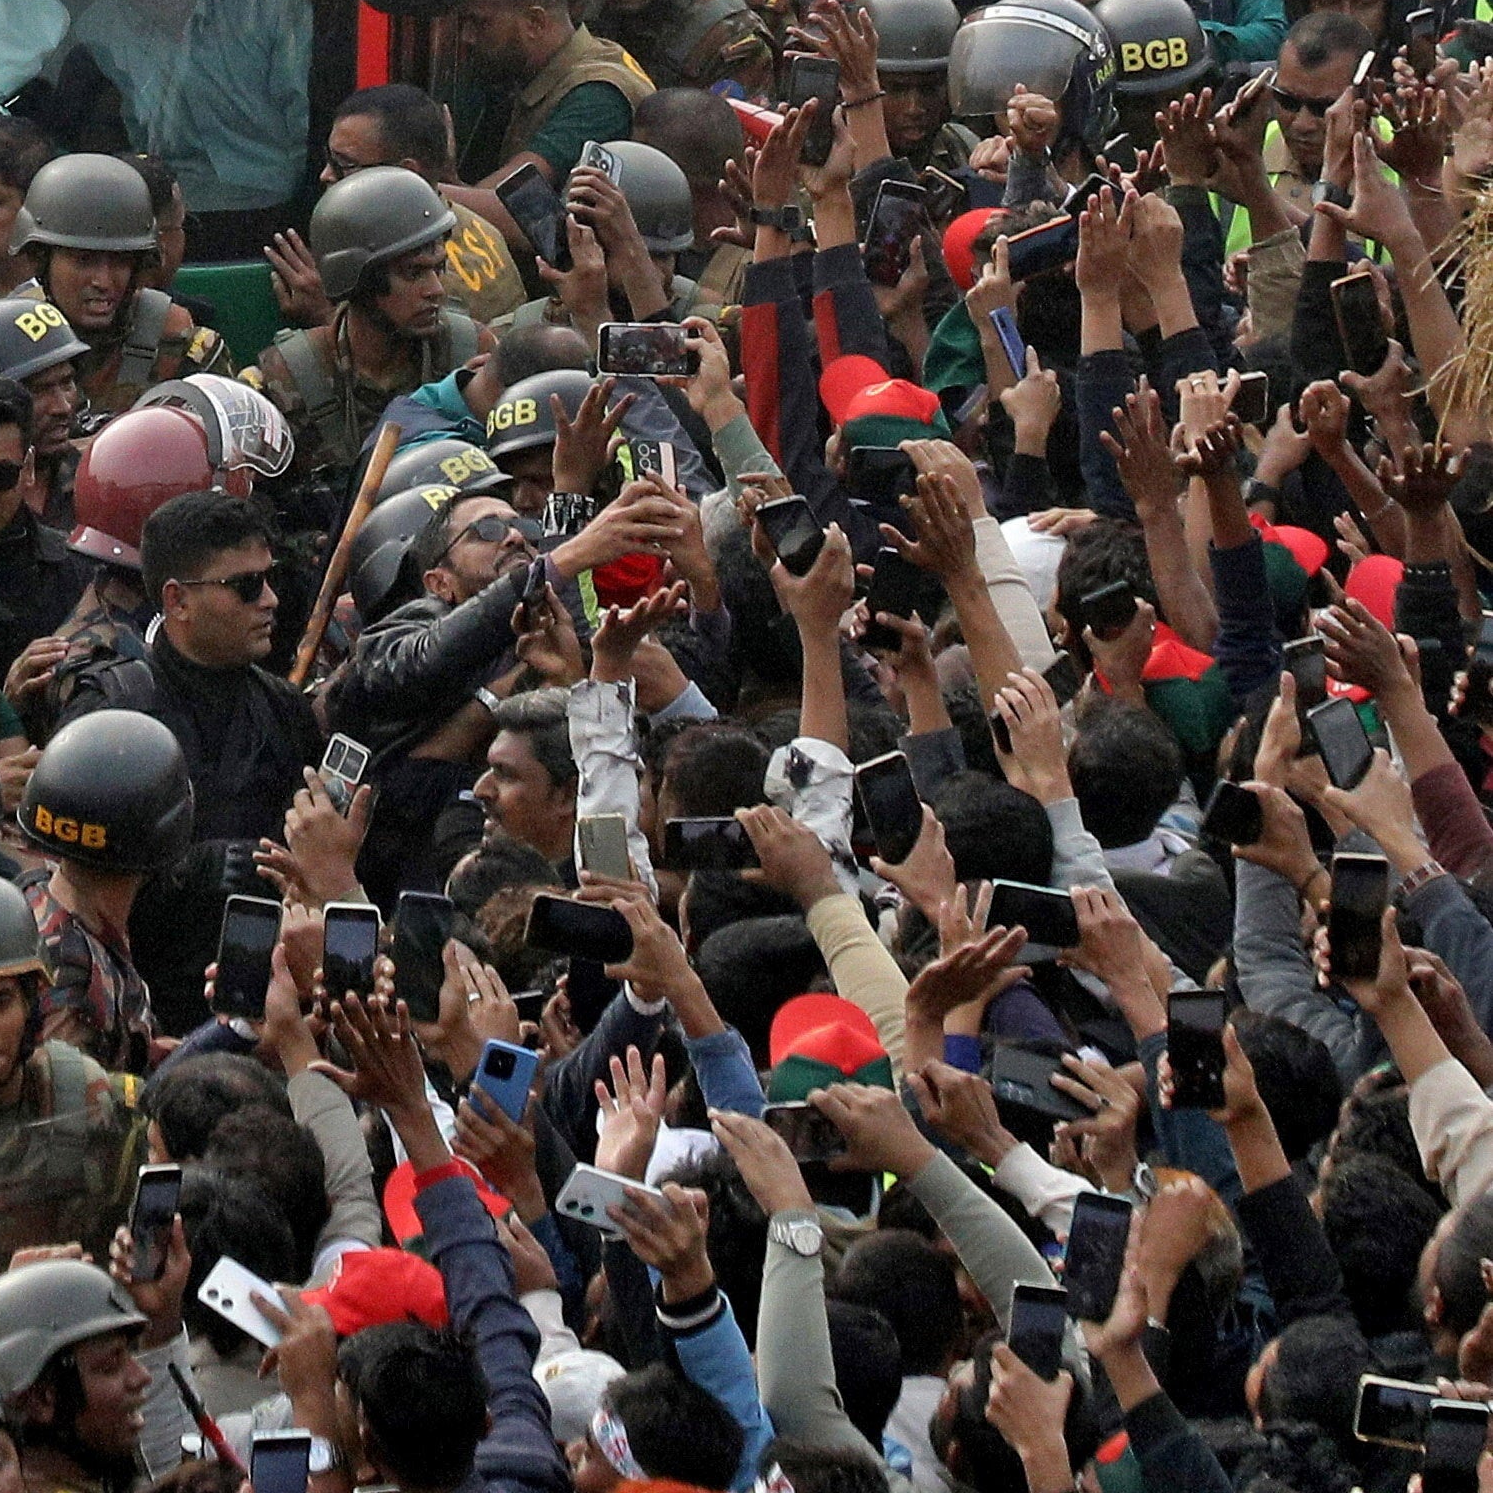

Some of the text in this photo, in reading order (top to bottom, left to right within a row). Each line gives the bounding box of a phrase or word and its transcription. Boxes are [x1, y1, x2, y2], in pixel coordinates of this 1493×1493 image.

[1121, 36, 1187, 73] BGB
[486, 397, 538, 440] BGB
[35, 804, 108, 848] BGB
